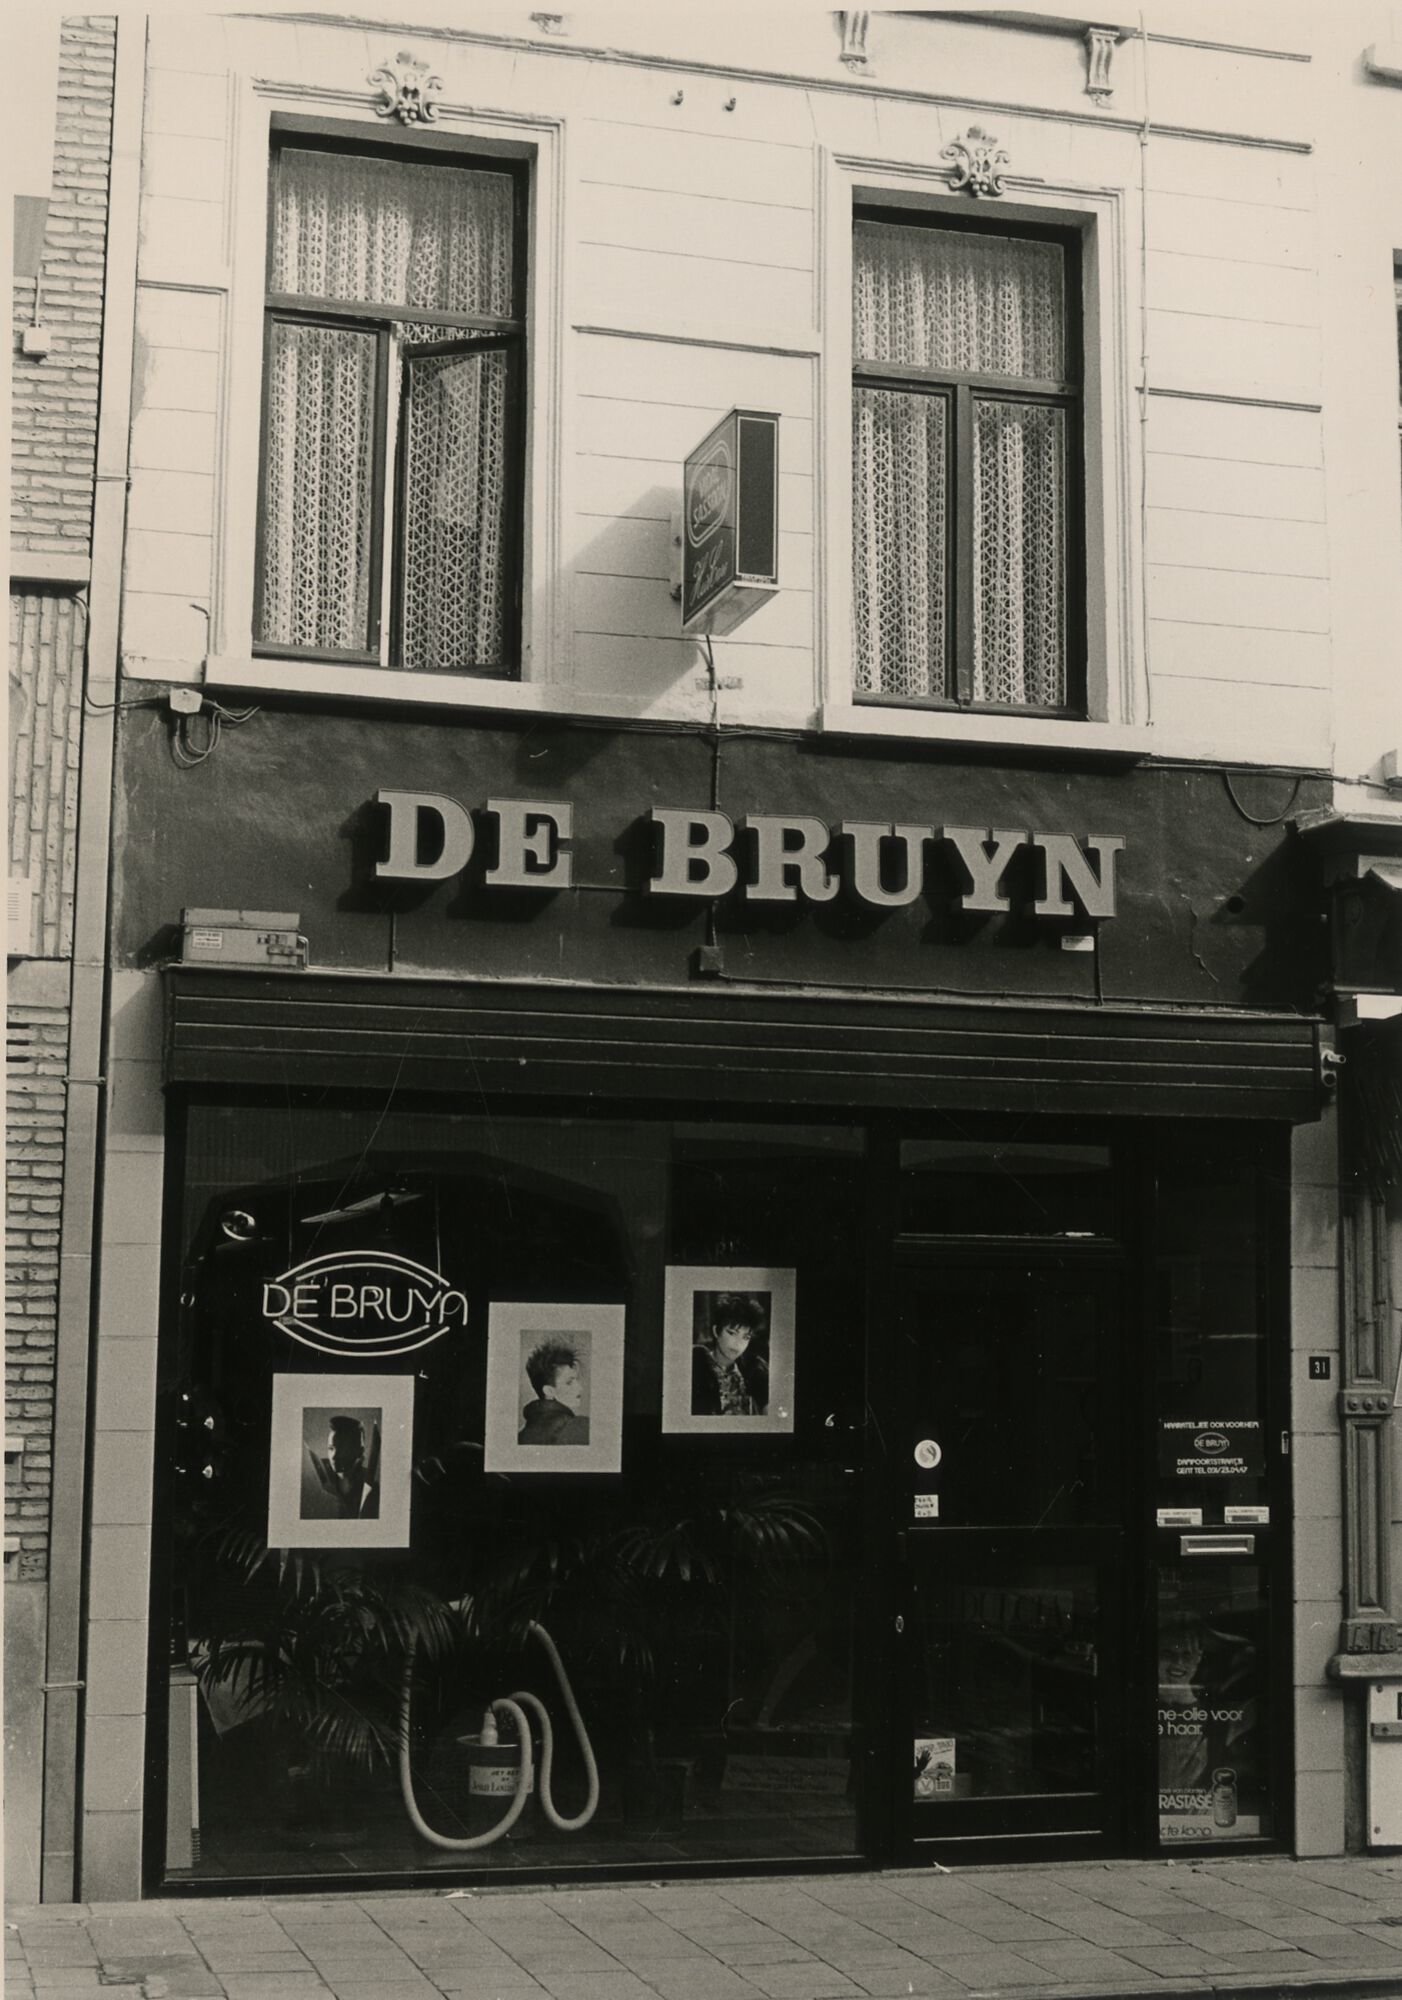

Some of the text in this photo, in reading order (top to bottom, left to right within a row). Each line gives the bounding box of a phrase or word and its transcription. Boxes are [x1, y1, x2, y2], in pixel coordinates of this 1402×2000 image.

[376, 788, 1127, 918] DE BRUYN
[262, 1283, 321, 1318] DE
[1314, 1361, 1326, 1374] 31
[1210, 1421, 1225, 1429] OOK
[1225, 1421, 1244, 1429] VOOR
[1194, 1440, 1204, 1448] DE
[1211, 1708, 1244, 1721] voor
